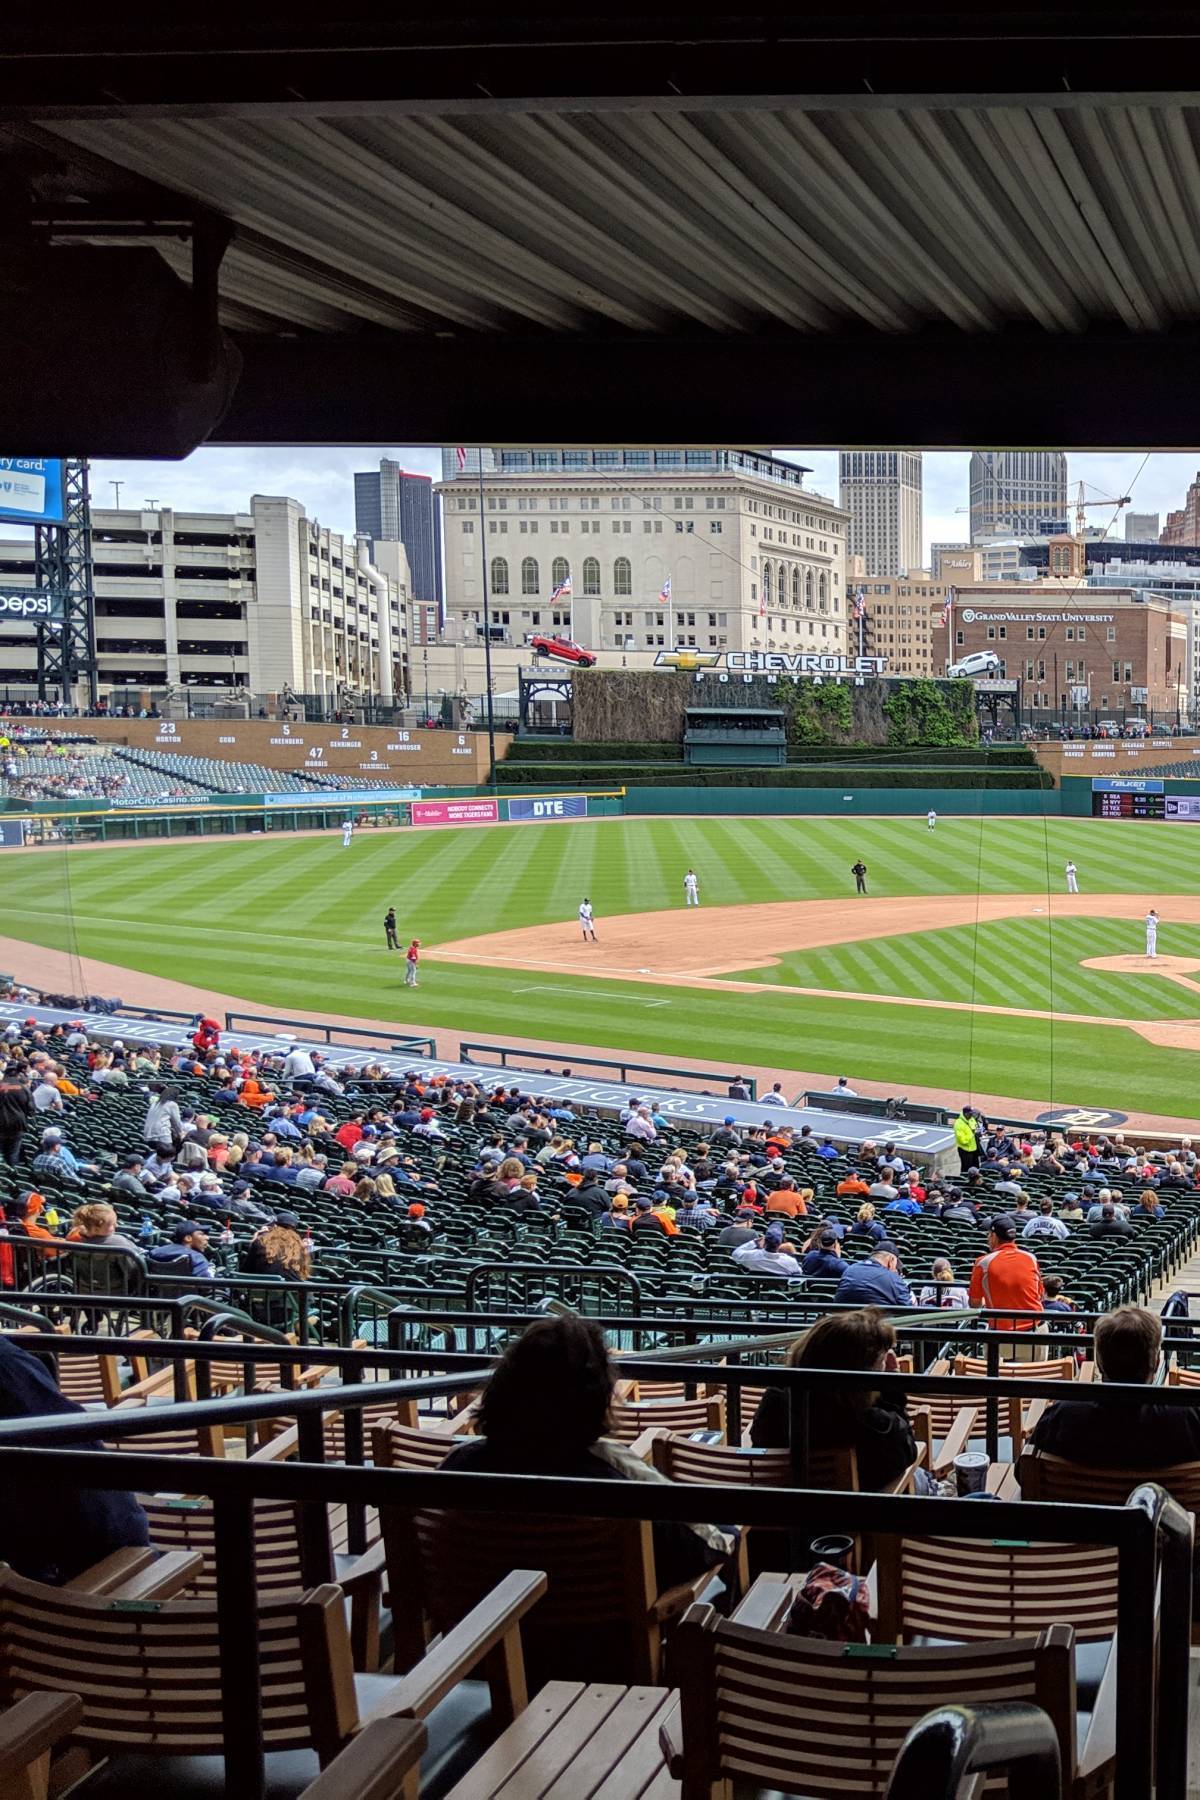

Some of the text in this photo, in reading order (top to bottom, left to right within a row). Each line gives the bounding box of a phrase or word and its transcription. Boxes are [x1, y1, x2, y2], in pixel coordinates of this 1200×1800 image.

[950, 560, 973, 570] Ashley
[975, 612, 1114, 623] GRAND VALLEY STATE UNIVERSITY
[727, 651, 889, 673] CHEVROLET
[696, 673, 865, 686] FOUNTAIN
[160, 723, 176, 734] 23
[283, 725, 290, 735] 5
[342, 728, 349, 739] 2
[398, 731, 410, 741] 16
[458, 735, 465, 745] 6
[309, 747, 324, 758] 47
[371, 751, 378, 761] 3
[111, 796, 210, 806] MotorCityCasino.com
[534, 801, 564, 816] DTE
